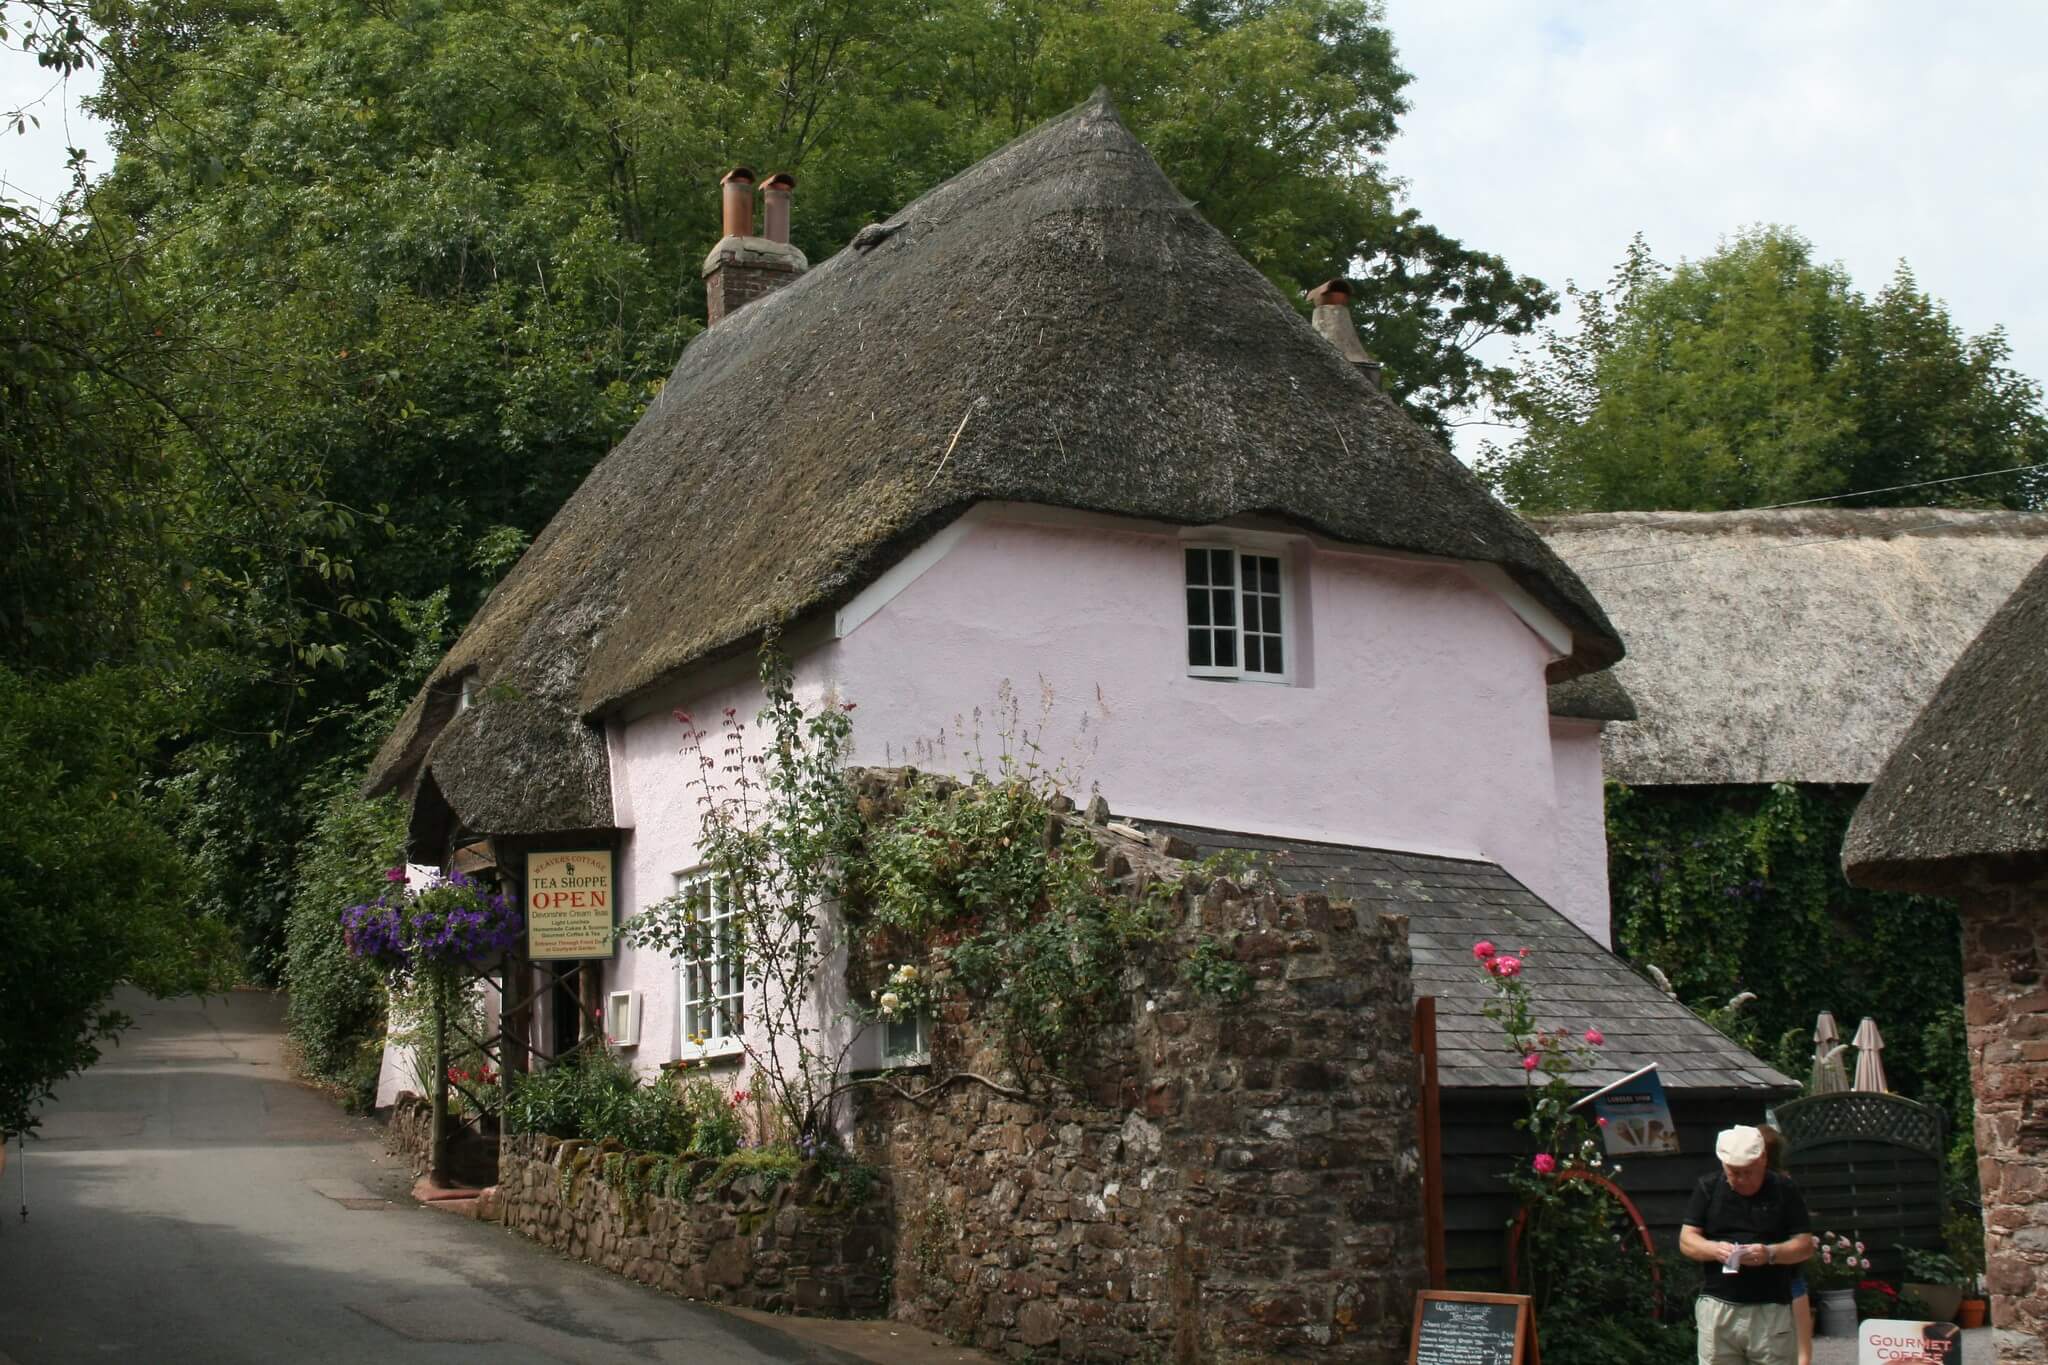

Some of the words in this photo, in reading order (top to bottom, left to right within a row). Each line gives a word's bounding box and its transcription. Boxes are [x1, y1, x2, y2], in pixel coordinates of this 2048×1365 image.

[571, 855, 607, 873] COTTAGE
[532, 877, 557, 889] TEA
[561, 876, 607, 888] SHOPPE
[532, 890, 606, 909] OPEN
[532, 911, 568, 919] Devonshire
[594, 909, 609, 917] Teas
[1869, 1334, 1953, 1351] GOURMET
[1876, 1347, 1944, 1361] COFFEE
